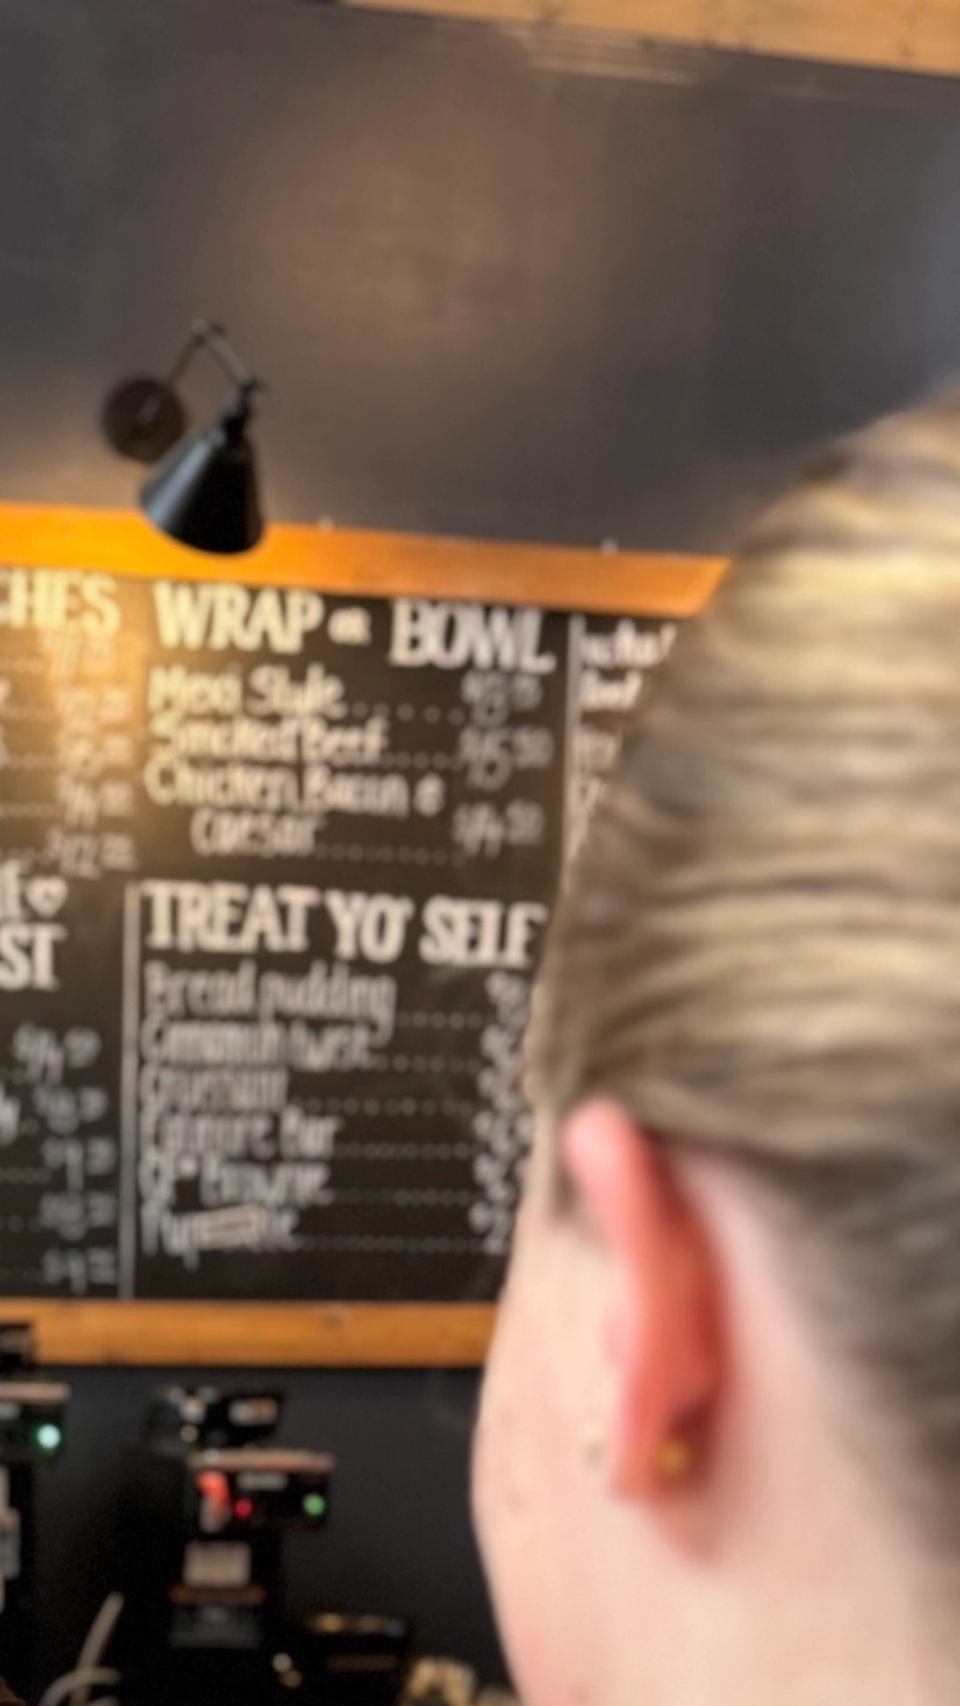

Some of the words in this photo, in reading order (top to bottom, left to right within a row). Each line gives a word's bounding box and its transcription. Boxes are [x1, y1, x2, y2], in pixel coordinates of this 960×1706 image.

[154, 580, 324, 652] WRAP
[388, 598, 556, 673] BOWL
[141, 878, 322, 953] TREAT
[418, 895, 549, 968] SELF
